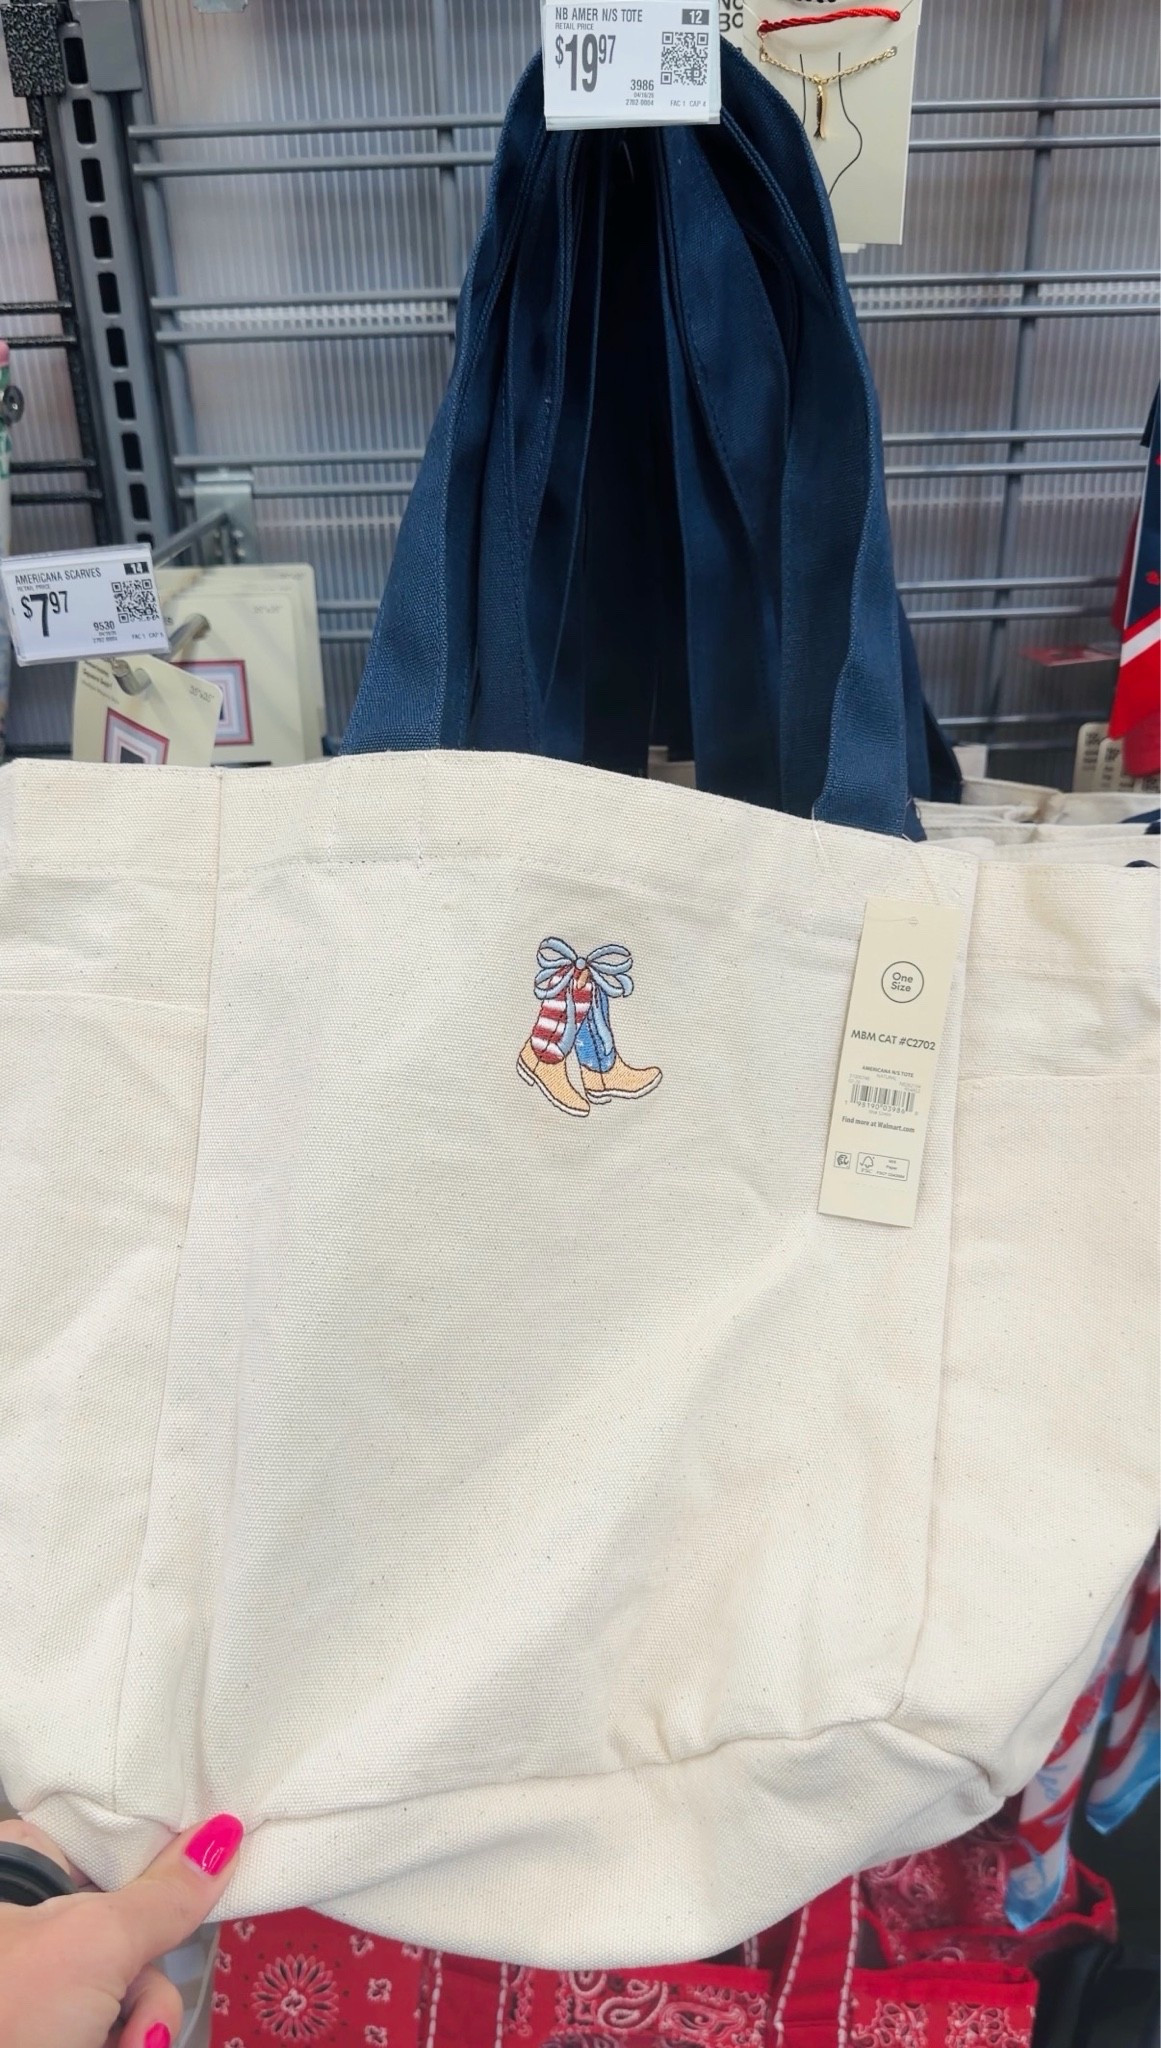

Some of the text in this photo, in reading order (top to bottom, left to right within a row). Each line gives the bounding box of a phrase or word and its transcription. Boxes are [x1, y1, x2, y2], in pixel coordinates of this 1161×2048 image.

[555, 8, 643, 23] NB AMER N/S TOTE
[689, 10, 702, 24] 12
[555, 22, 594, 31] RETAIL PRICE
[630, 79, 655, 91] 3986
[130, 562, 144, 574] 14
[15, 567, 102, 586] AMERICANA SCARVES
[93, 620, 116, 631] 9530
[892, 972, 913, 983] One
[891, 981, 911, 992] Size
[851, 1030, 936, 1050] MBM CAT #C2702
[862, 1065, 891, 1074] AMERICANA
[855, 1119, 870, 1127] more
[877, 1121, 915, 1133] Walmart.com
